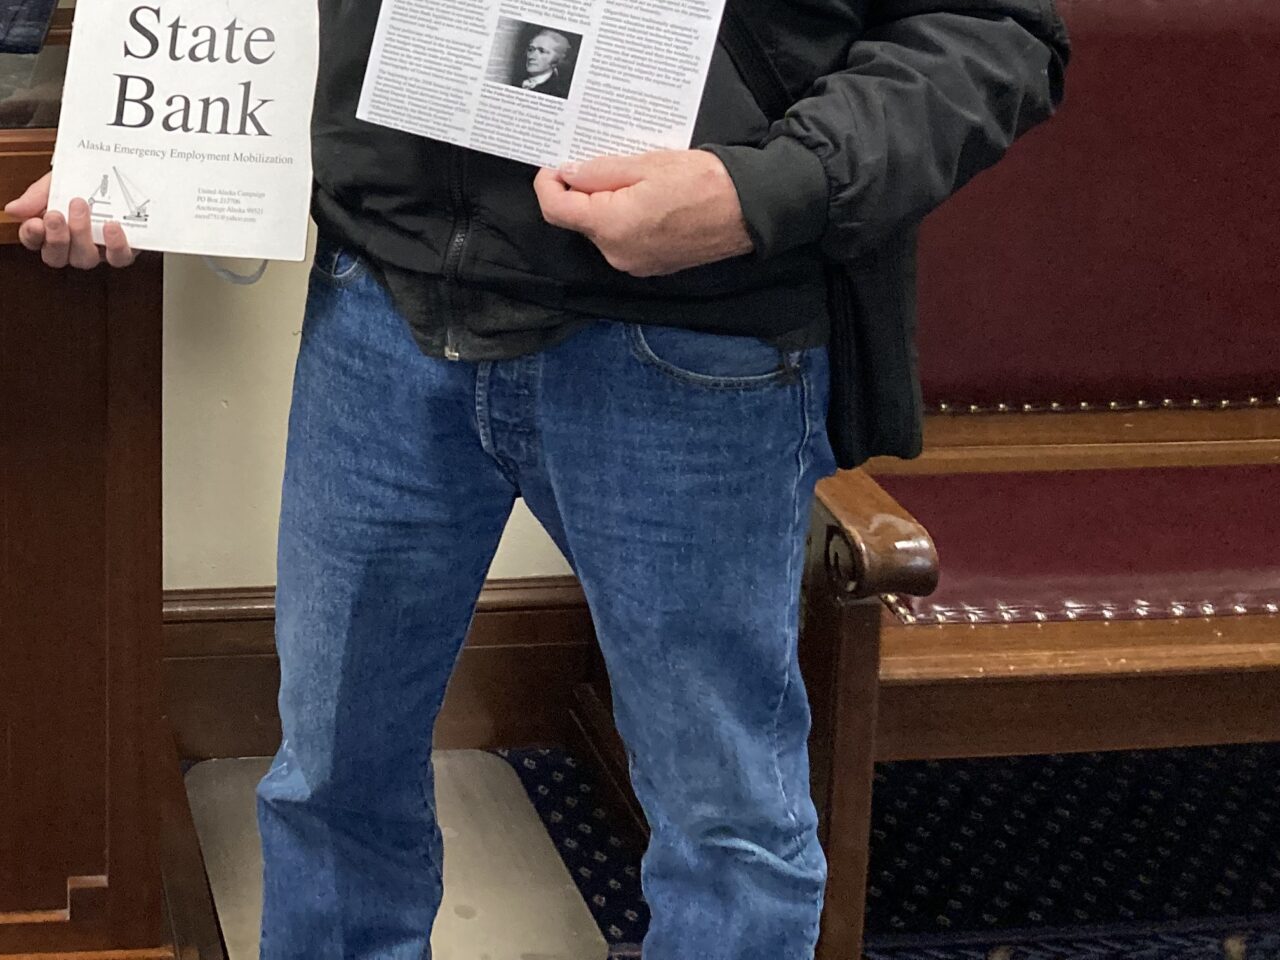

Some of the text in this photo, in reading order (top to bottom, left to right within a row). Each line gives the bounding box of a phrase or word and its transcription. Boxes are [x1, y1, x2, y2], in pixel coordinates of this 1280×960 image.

[123, 5, 276, 64] State
[106, 72, 275, 137] Bank
[77, 139, 293, 165] Alaska Emergency Employment Mobilization
